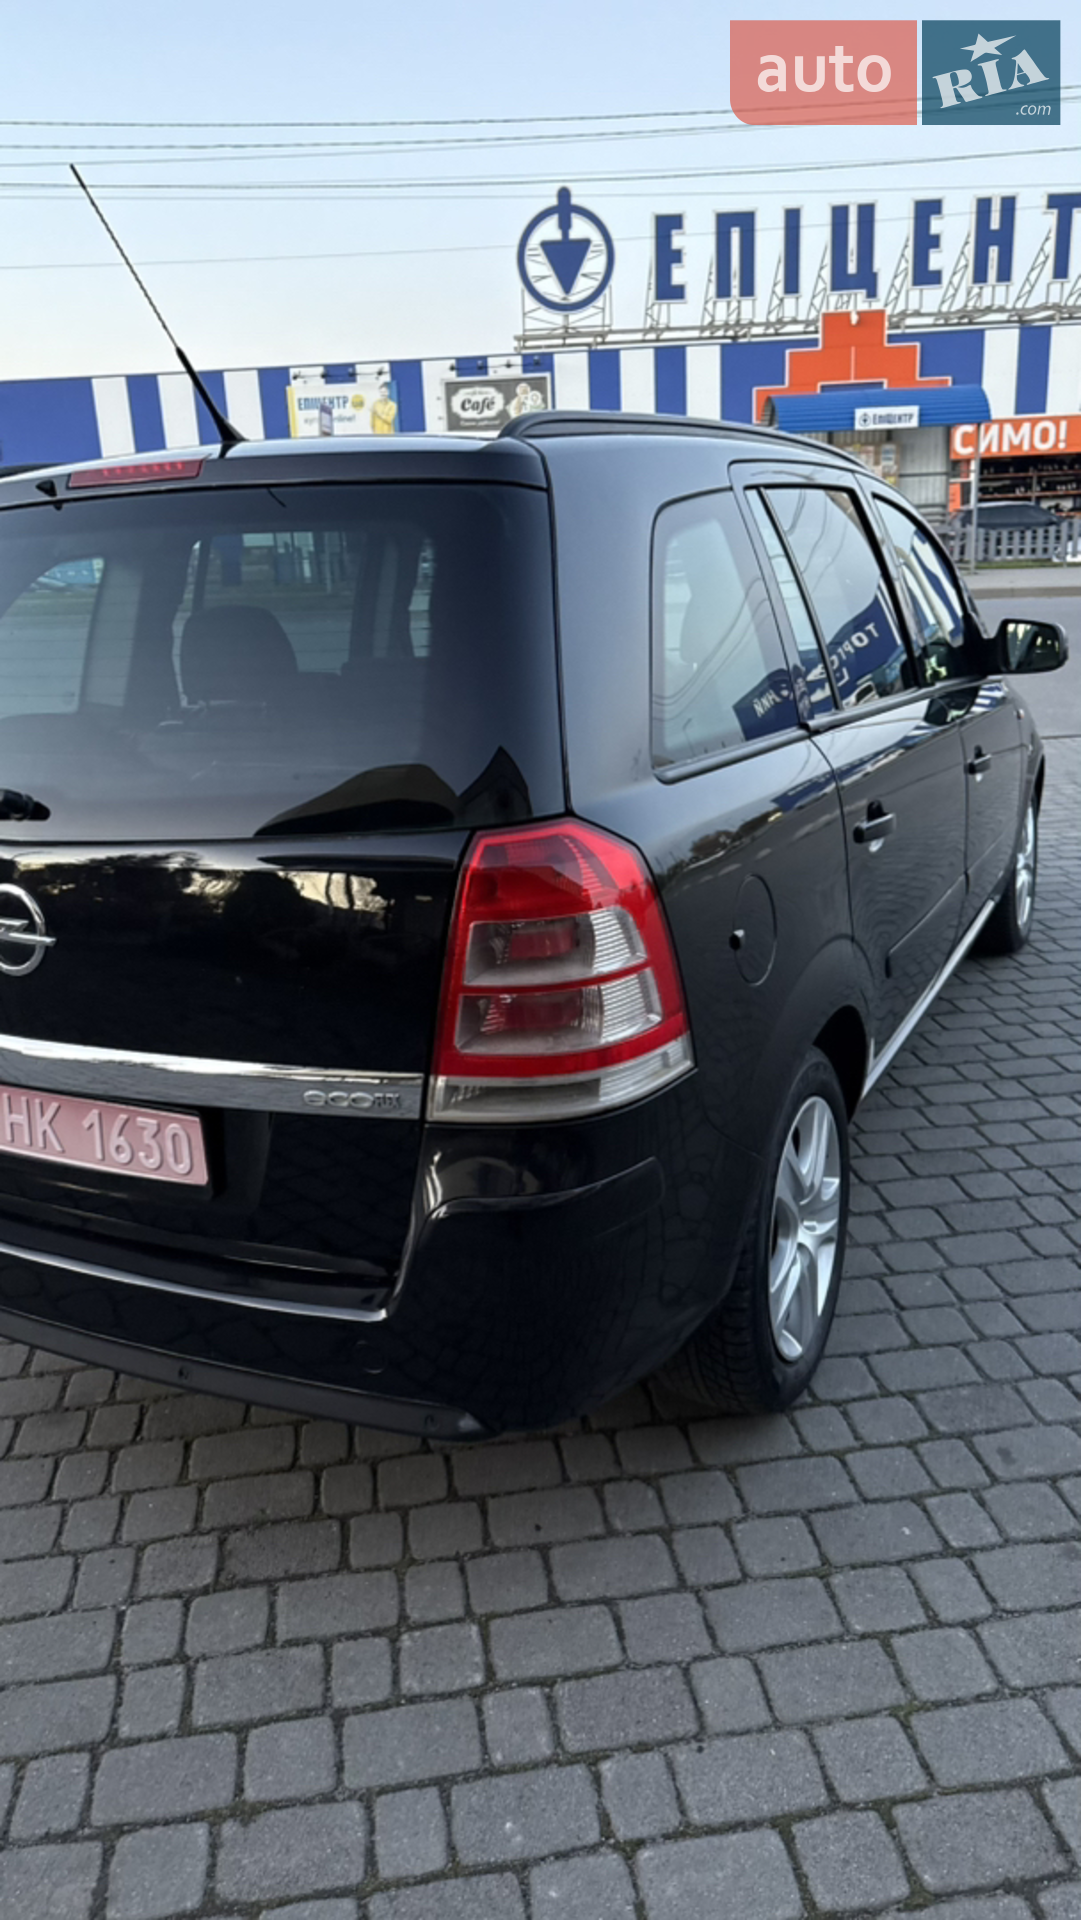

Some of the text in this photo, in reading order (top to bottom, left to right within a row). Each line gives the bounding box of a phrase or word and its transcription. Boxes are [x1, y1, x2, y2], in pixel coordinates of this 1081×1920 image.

[461, 396, 496, 415] Café
[2, 1093, 193, 1176] HK 1630
